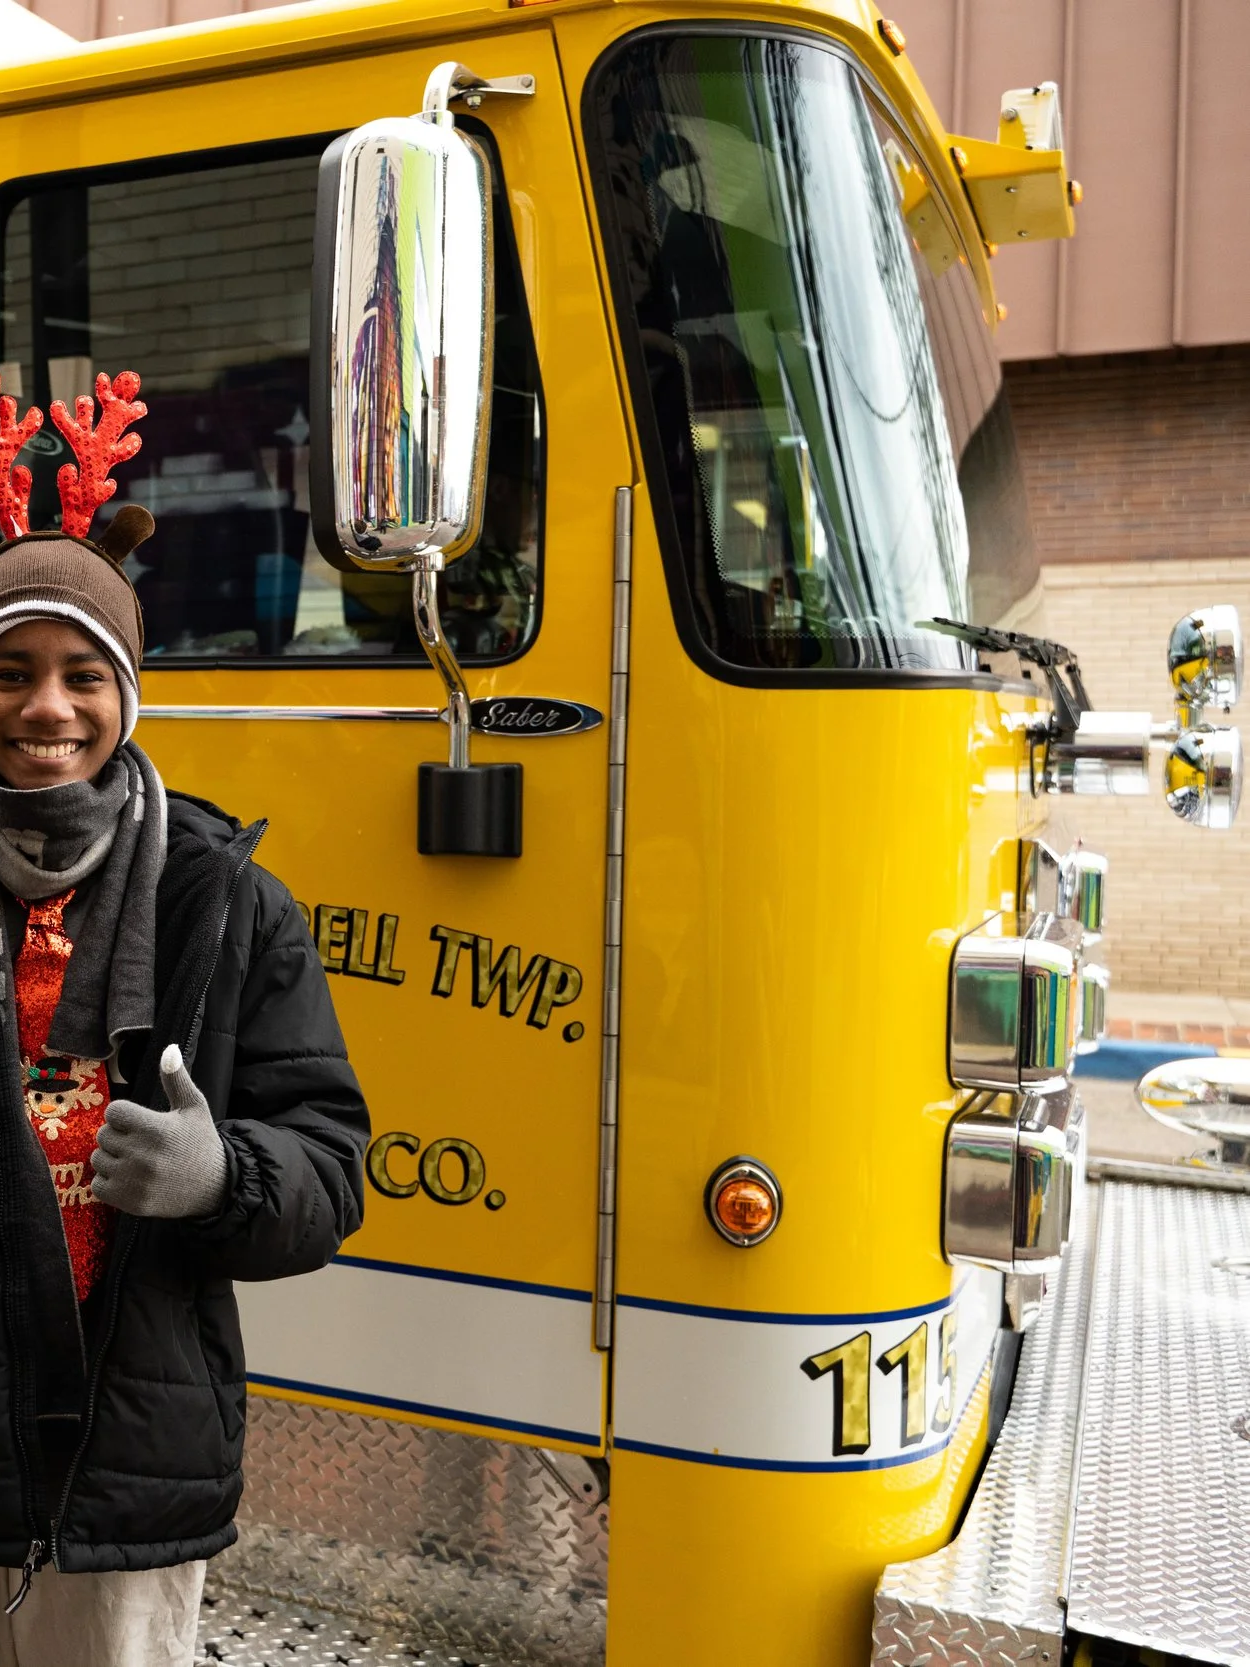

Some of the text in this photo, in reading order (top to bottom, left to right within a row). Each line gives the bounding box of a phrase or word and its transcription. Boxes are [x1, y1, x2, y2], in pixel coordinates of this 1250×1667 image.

[481, 702, 561, 728] Saber
[296, 901, 585, 1043] ELL TWP.
[49, 1162, 85, 1192] rry
[365, 1132, 506, 1211] CO.
[800, 1303, 958, 1457] 115
